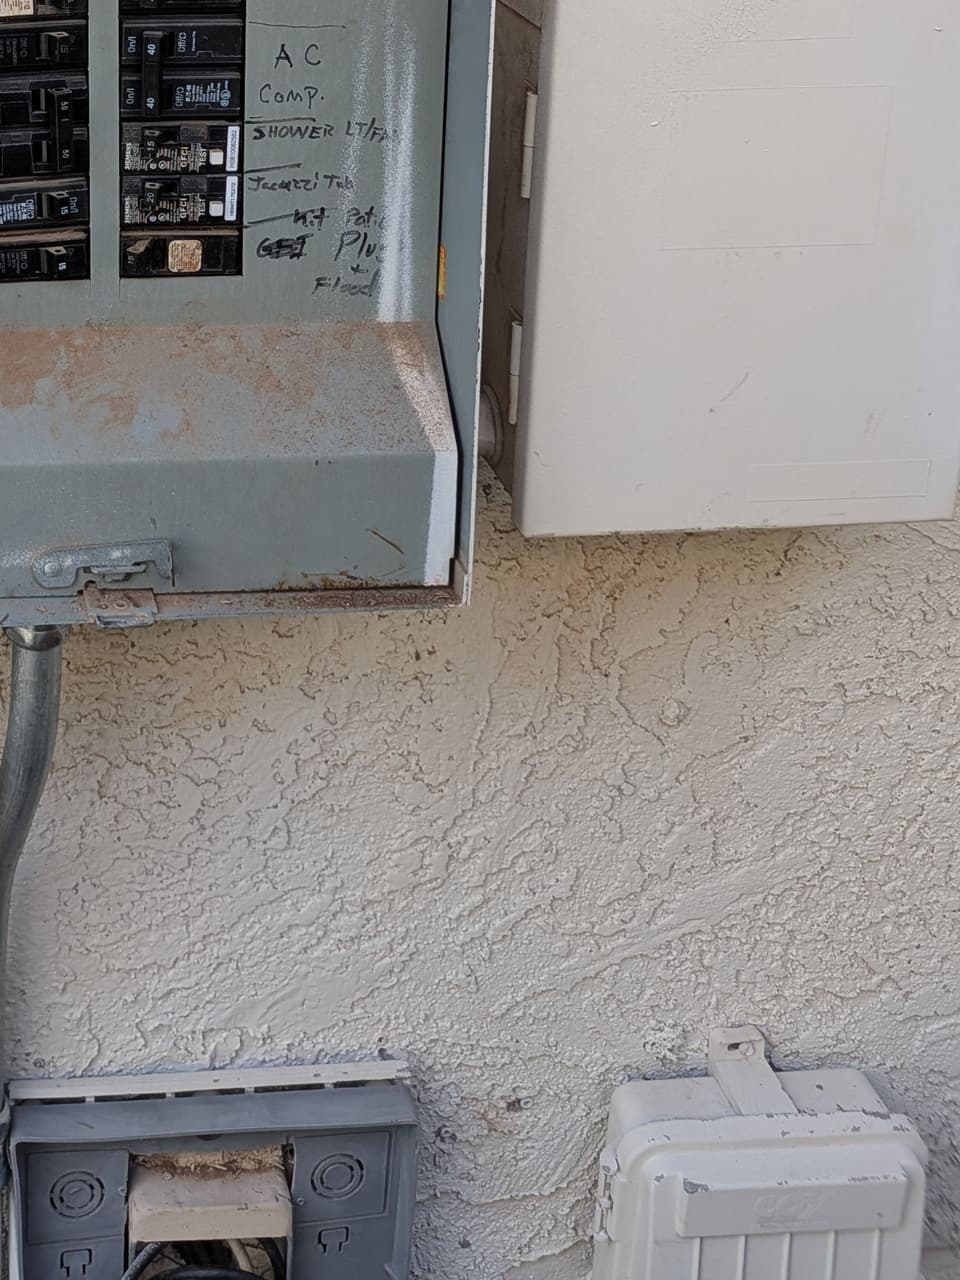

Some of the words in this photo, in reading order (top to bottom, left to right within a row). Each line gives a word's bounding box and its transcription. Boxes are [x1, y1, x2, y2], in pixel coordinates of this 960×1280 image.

[146, 43, 156, 56] 40
[146, 97, 155, 109] 40
[252, 125, 335, 140] SHOWER
[146, 140, 155, 151] 15
[181, 146, 189, 168] GFCI
[199, 148, 208, 166] TEST
[146, 192, 155, 202] 20
[61, 206, 69, 215] 15
[180, 198, 188, 219] GFCI
[127, 255, 135, 264] 15
